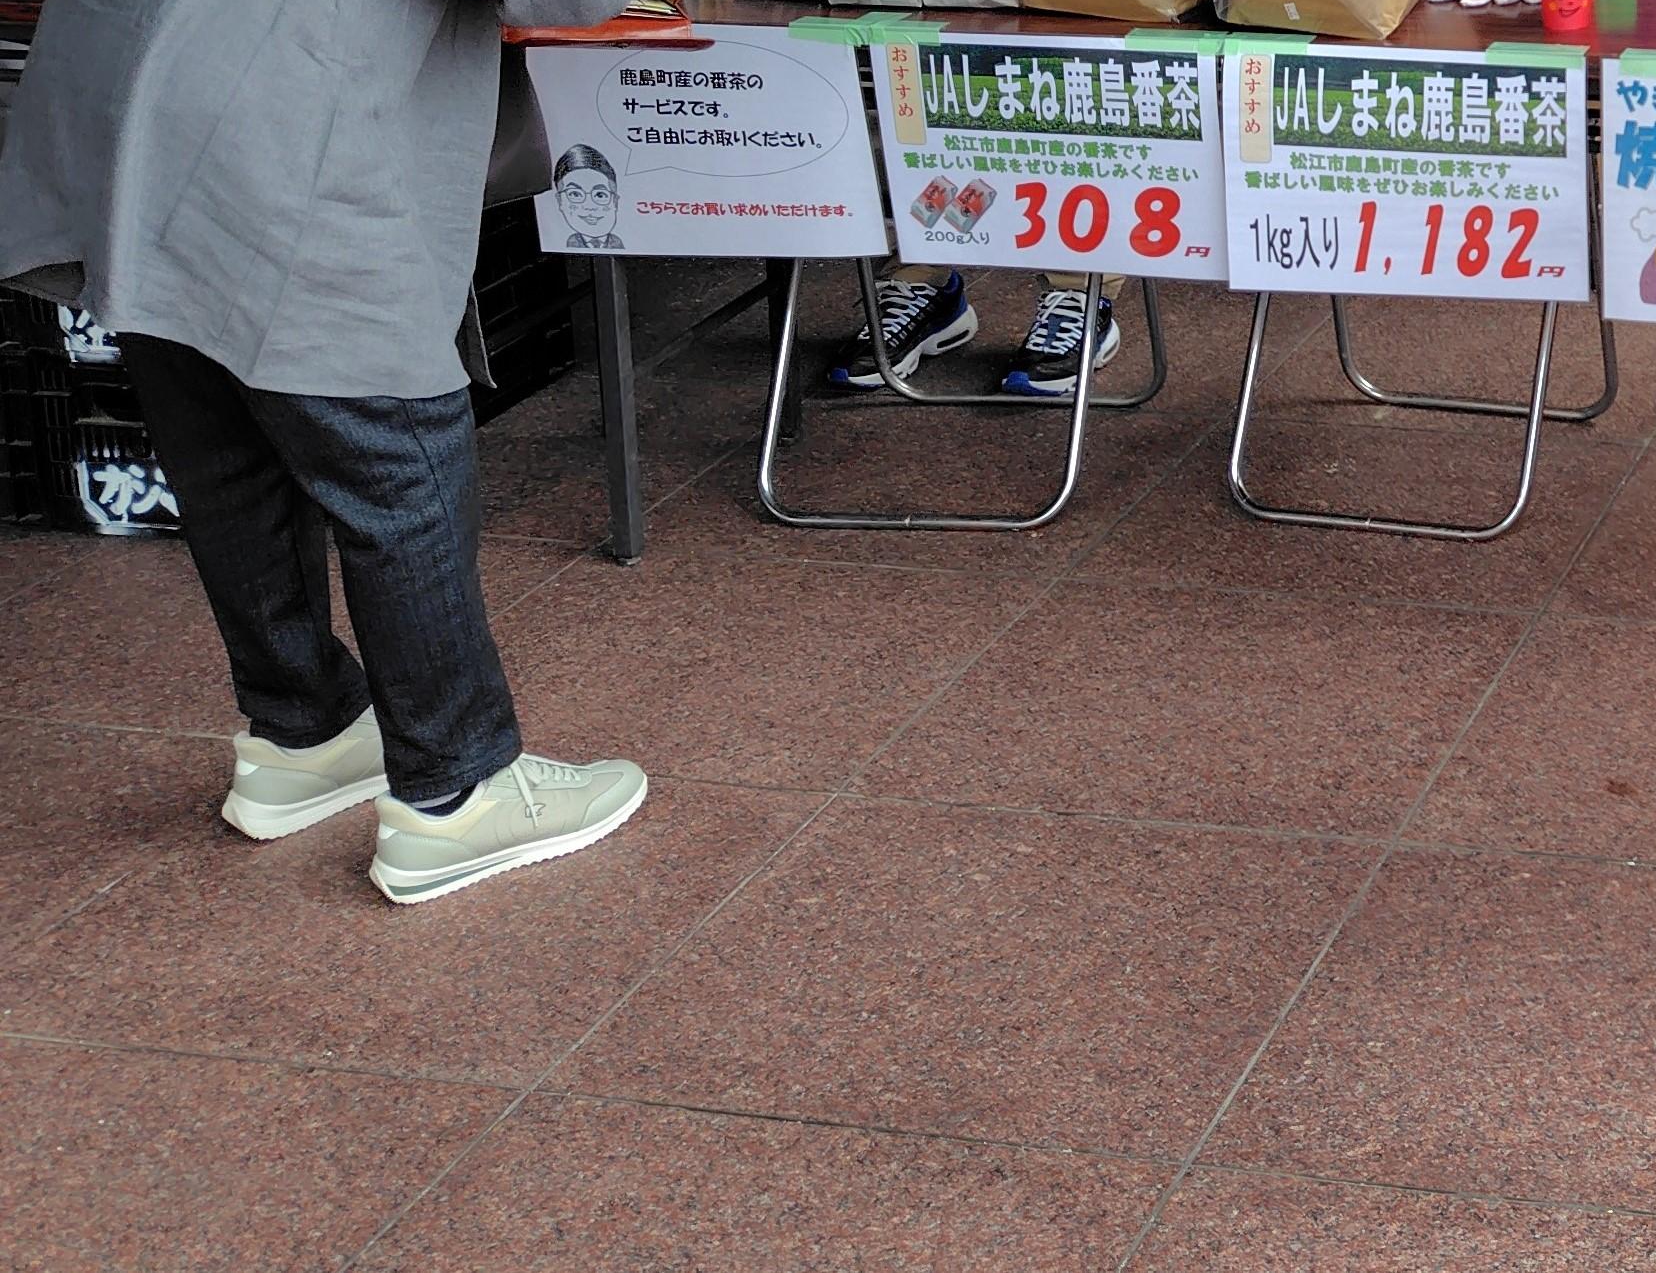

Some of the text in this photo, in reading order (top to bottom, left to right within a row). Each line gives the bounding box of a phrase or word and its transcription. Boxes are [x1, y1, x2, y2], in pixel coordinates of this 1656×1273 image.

[620, 69, 763, 91] 鹿島町産の番茶の
[891, 47, 914, 119] おすすめ
[924, 53, 1200, 130] JAしまね鹿島番茶
[622, 98, 730, 119] サービスです。
[1244, 59, 1262, 134] おすすめ
[1275, 67, 1566, 147] JAしまね鹿島番茶
[627, 127, 822, 149] ご自由にお取りください。
[943, 134, 1152, 161] 松江市鹿島町産の番茶です
[1289, 152, 1511, 178] 松江市鹿島町産の番茶です
[636, 201, 853, 217] こちらでお買い求めいただけます。
[924, 230, 990, 246] 200g入り
[1249, 213, 1340, 270] 1kg入り
